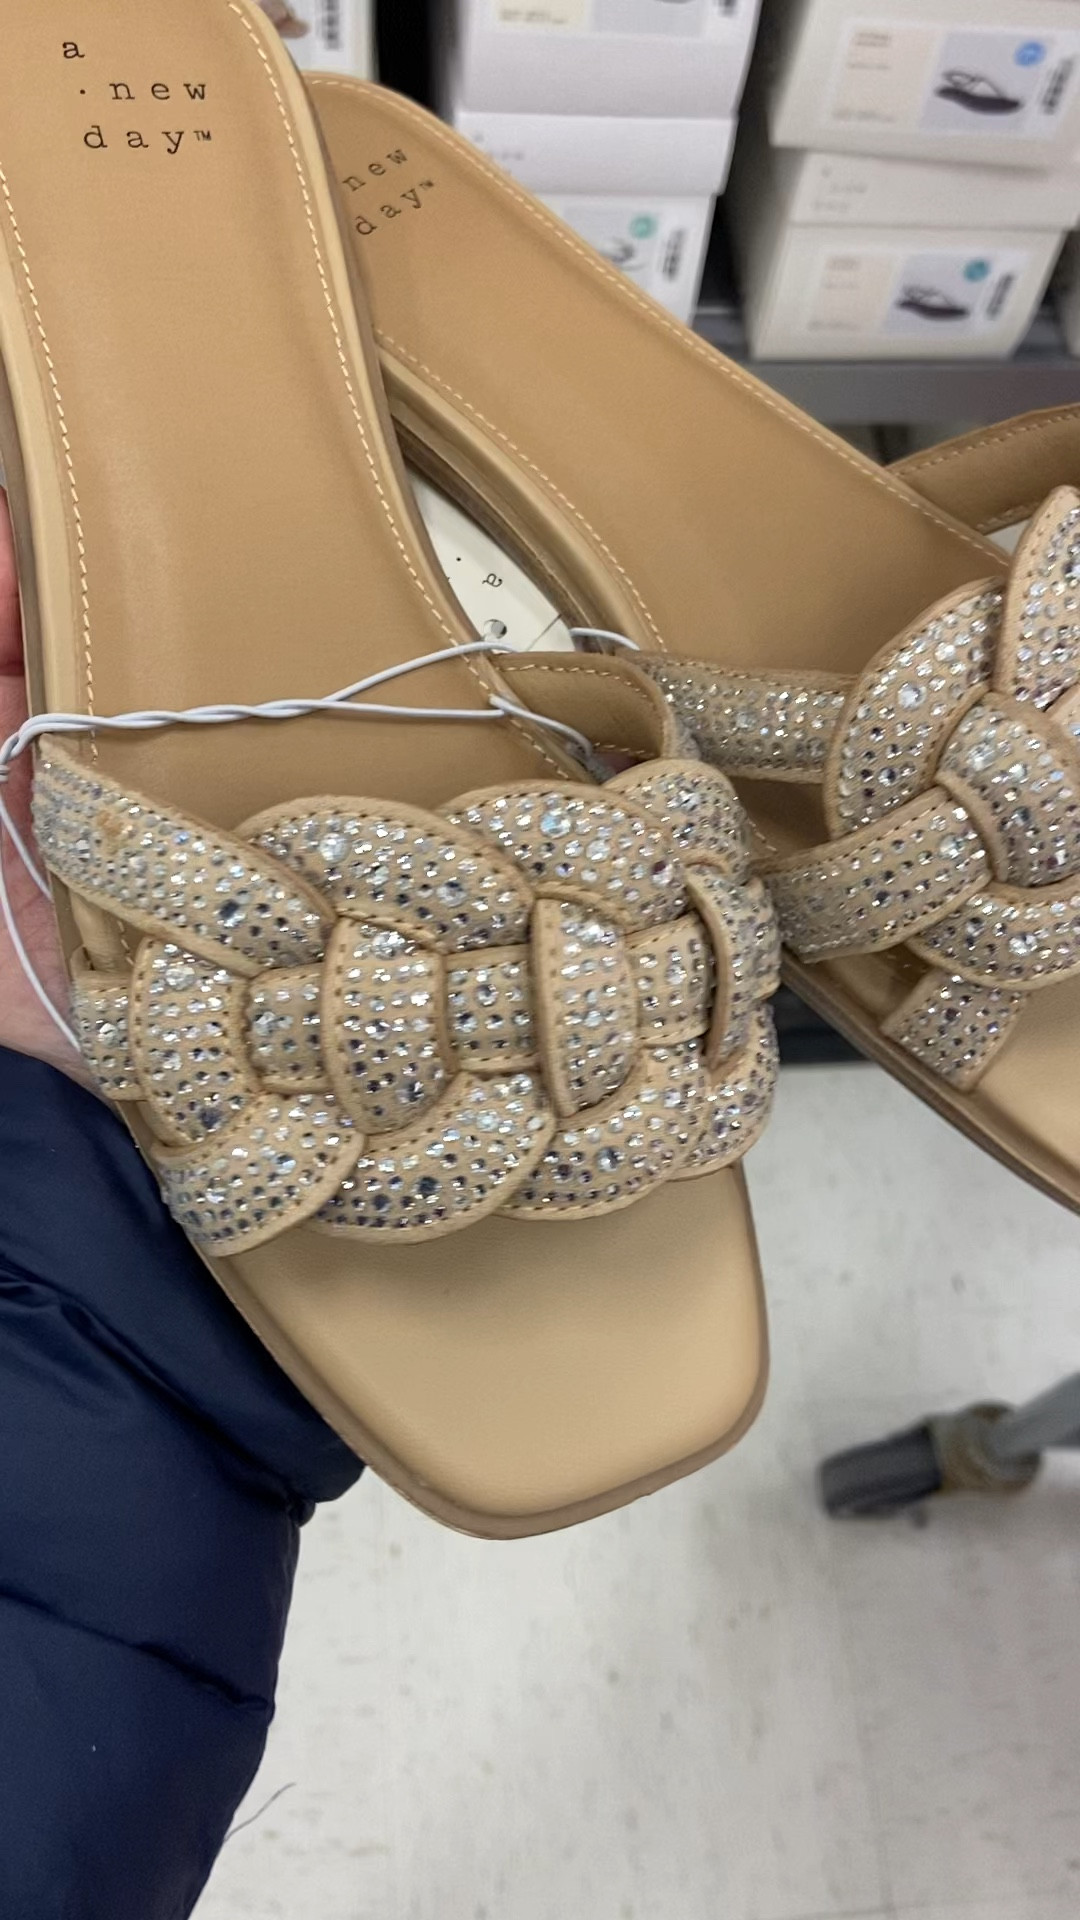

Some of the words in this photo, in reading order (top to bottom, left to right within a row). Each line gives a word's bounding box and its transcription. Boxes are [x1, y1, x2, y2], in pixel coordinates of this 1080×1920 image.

[62, 41, 85, 59] a
[109, 82, 206, 100] new
[342, 148, 408, 192] new
[482, 573, 503, 588] a
